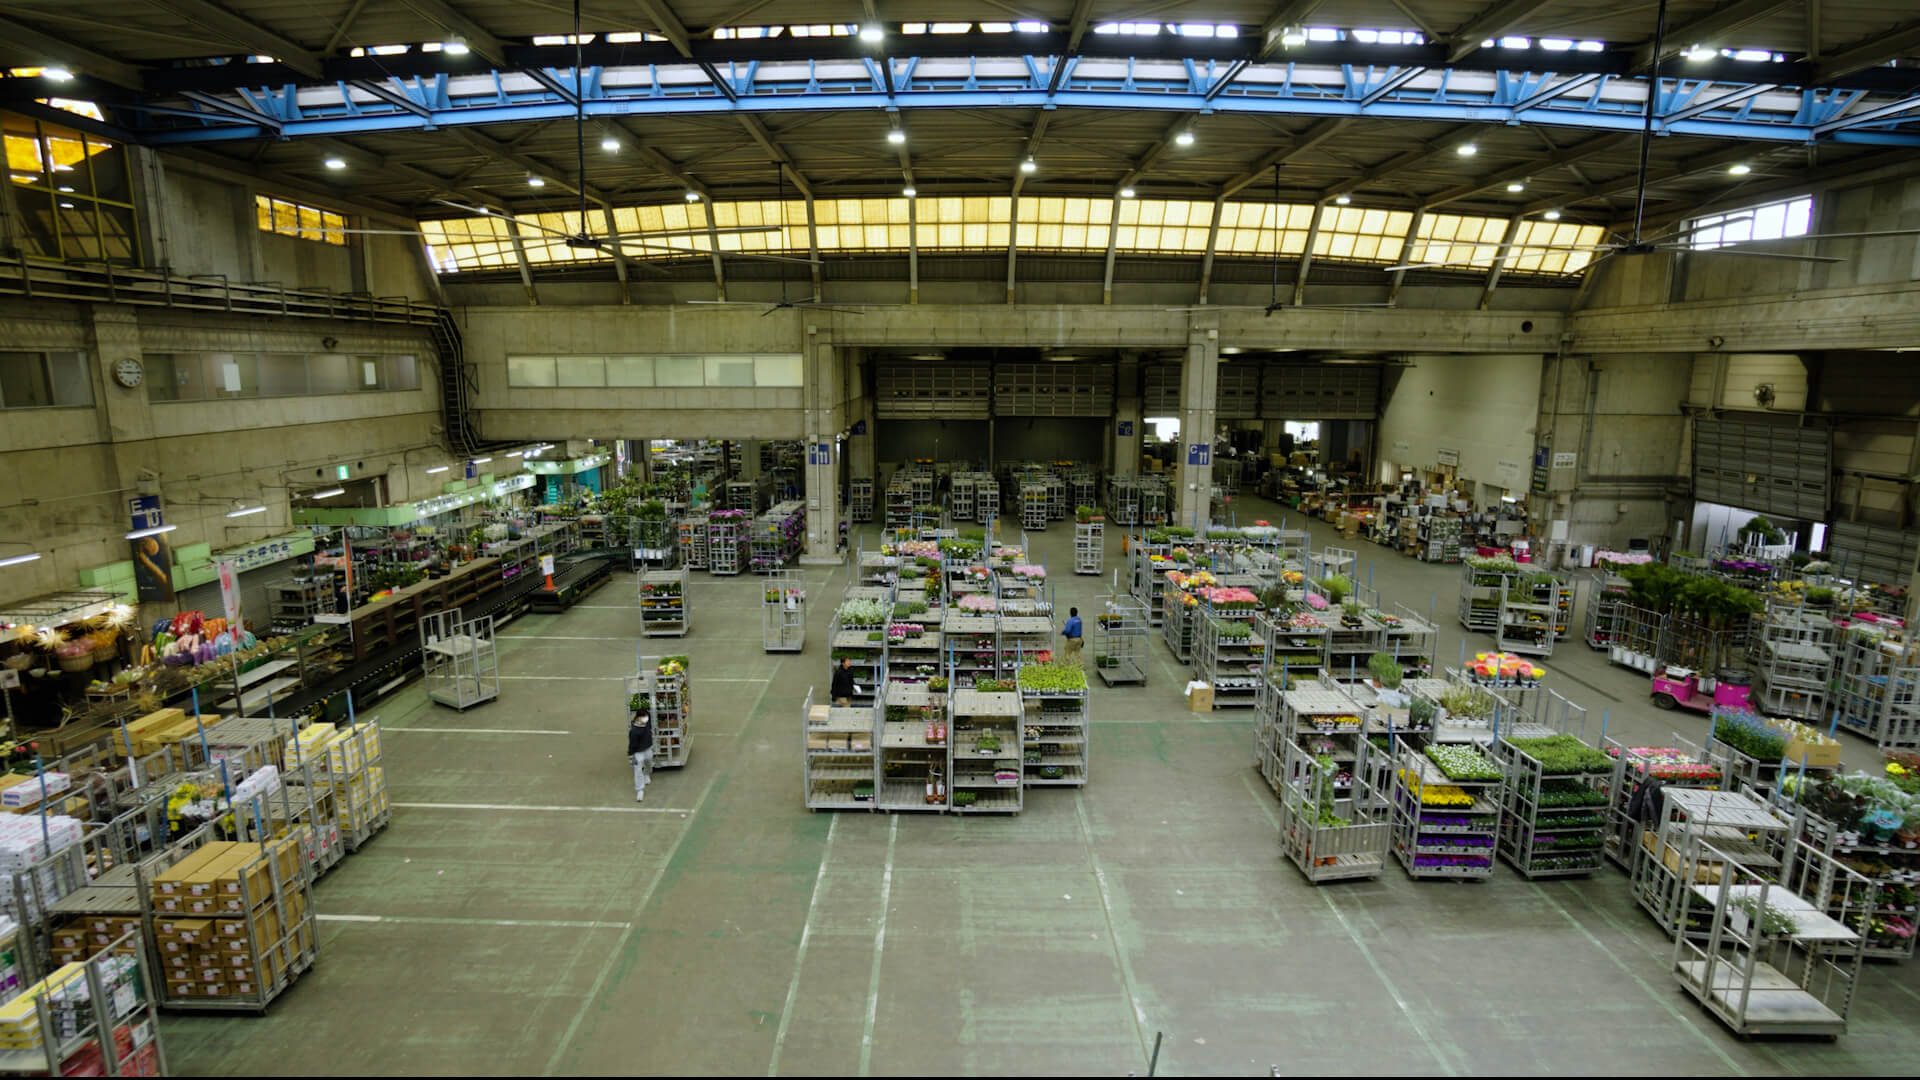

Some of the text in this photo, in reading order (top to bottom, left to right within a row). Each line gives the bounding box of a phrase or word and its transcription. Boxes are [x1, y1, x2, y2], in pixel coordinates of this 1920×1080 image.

[1190, 445, 1207, 464] C 11
[131, 500, 160, 528] E 10
